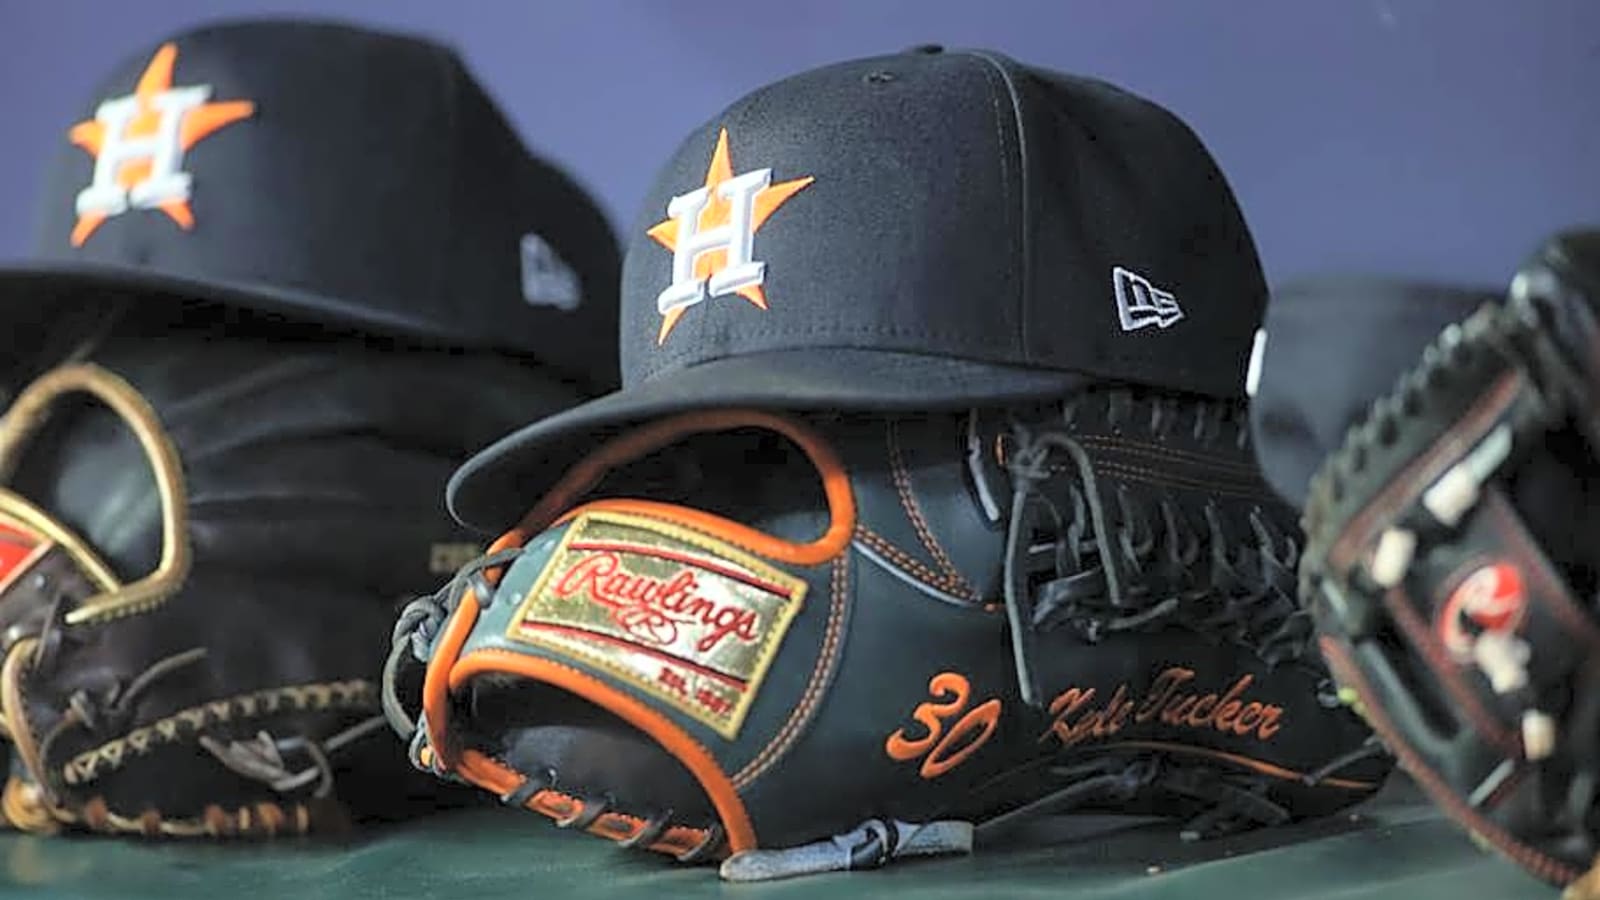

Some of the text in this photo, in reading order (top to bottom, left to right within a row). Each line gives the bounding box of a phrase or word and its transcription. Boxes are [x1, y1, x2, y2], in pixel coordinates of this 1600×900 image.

[76, 83, 213, 217] H
[658, 168, 772, 315] H
[555, 550, 758, 652] Rawlings
[886, 672, 1001, 780] 30
[1136, 667, 1284, 740] Tucker
